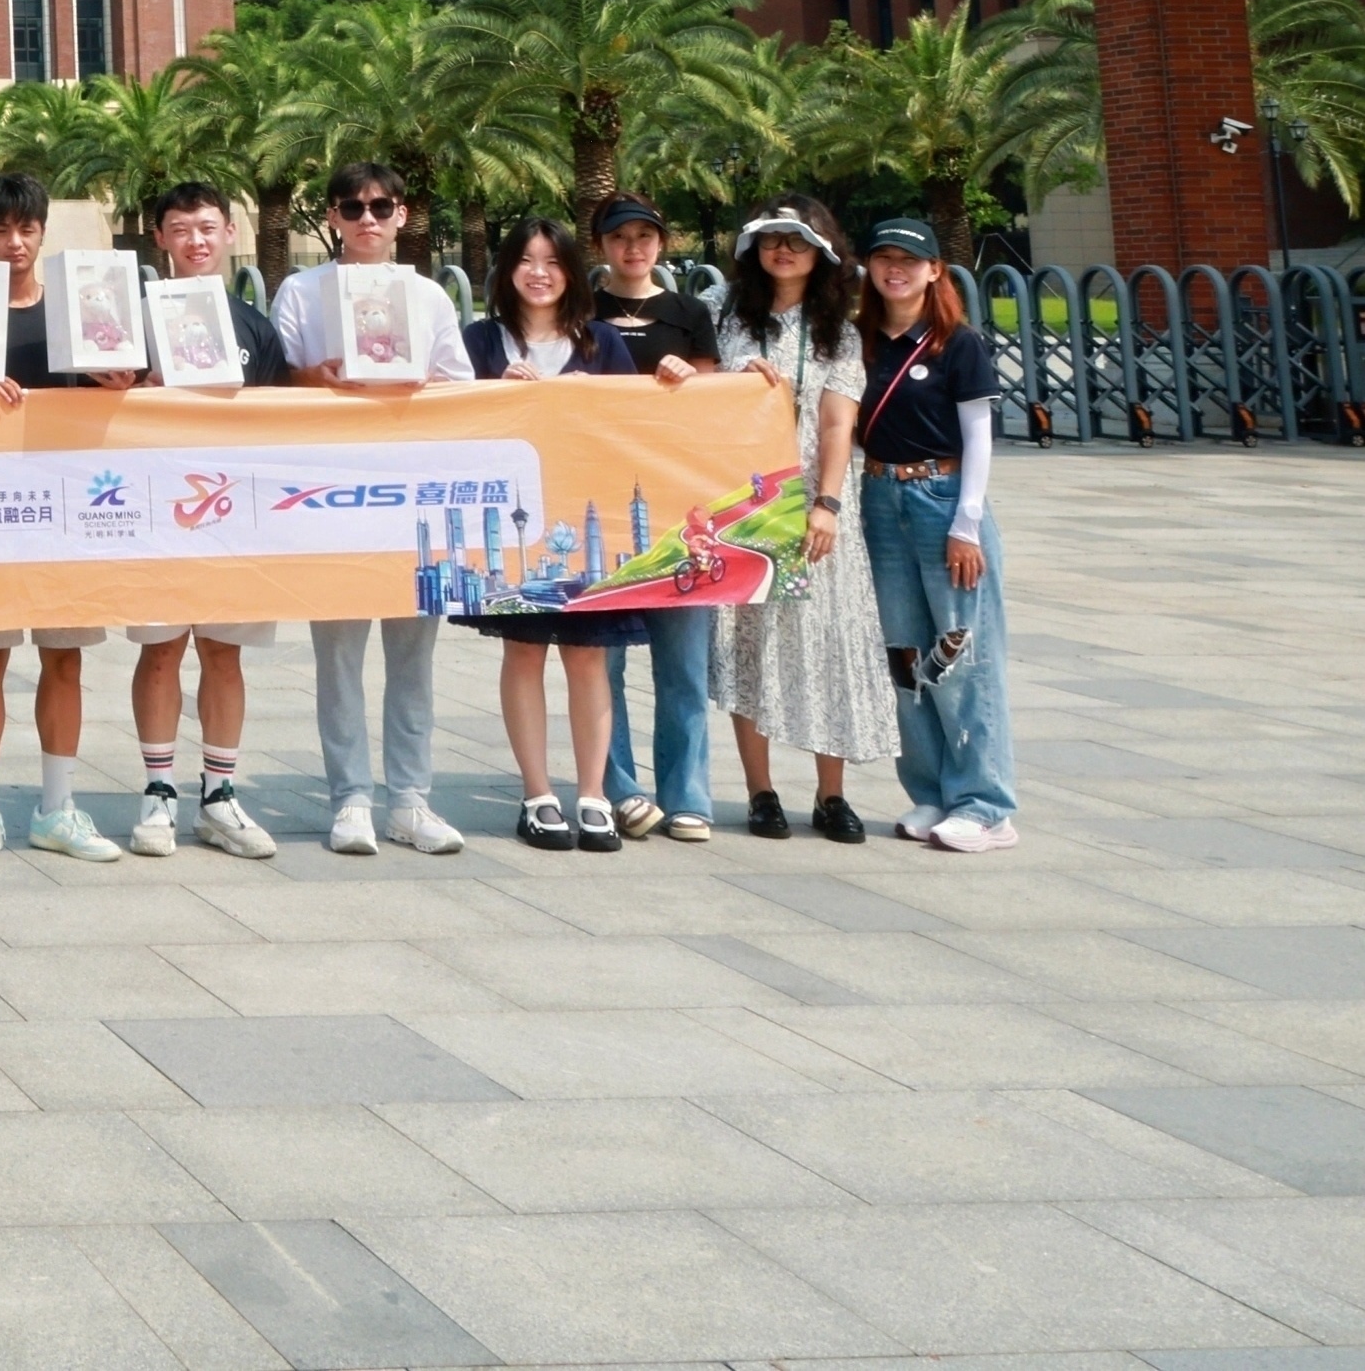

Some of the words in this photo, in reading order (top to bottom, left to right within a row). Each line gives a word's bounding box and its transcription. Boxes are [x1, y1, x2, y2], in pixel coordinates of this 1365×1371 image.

[415, 480, 510, 506] 喜德盛
[78, 512, 114, 521] GUANG
[115, 511, 142, 520] MING
